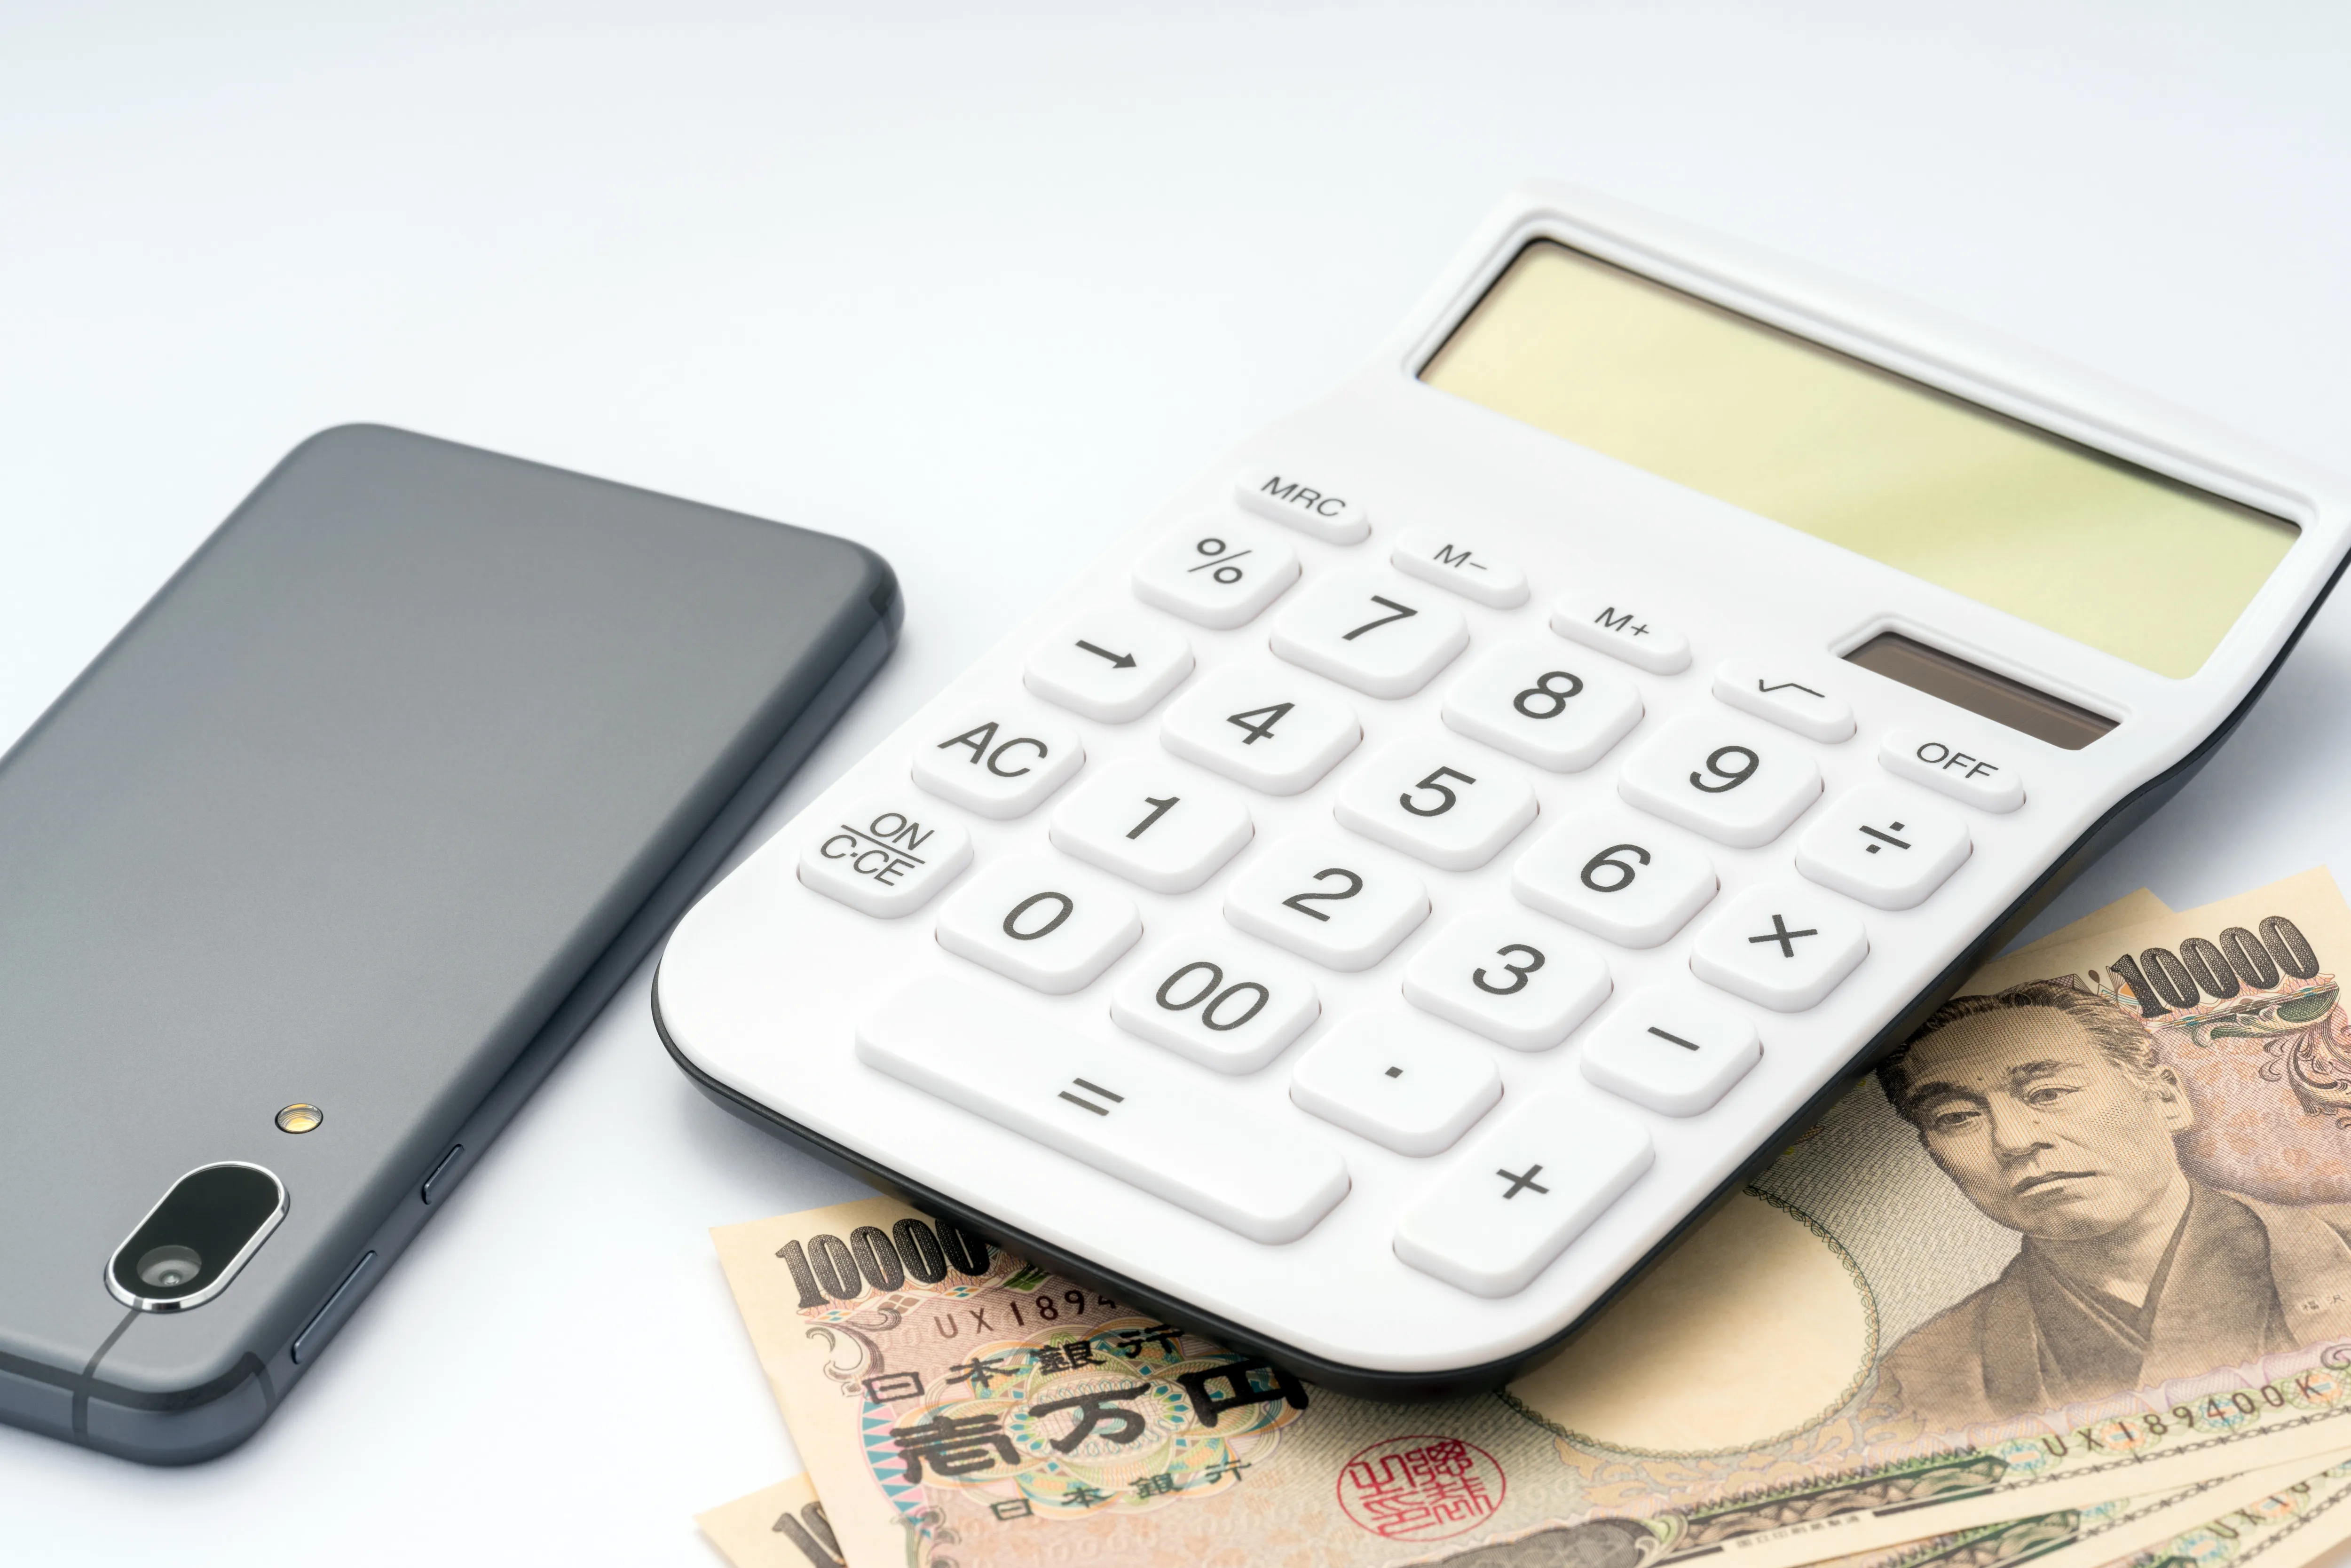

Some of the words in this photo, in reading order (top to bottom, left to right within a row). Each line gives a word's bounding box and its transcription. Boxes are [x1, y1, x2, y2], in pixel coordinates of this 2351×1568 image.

[1261, 476, 1346, 517] MRC
[1188, 537, 1252, 584] %
[1341, 595, 1419, 641] 7
[1594, 606, 1649, 636] M+
[1513, 670, 1584, 720] 8
[1226, 702, 1296, 746] 4
[936, 721, 1049, 778] AC
[1689, 745, 1760, 794] 9
[1916, 742, 1999, 779] OFF
[1399, 765, 1477, 818] 5
[869, 812, 935, 851] ON
[1125, 796, 1181, 840] 1
[1580, 843, 1651, 893] 6
[1002, 891, 1074, 941] 0
[1281, 867, 1364, 922] 2
[1472, 943, 1546, 996] 3
[2110, 915, 2320, 1018] 10000
[1155, 961, 1270, 1032] 00
[1057, 1077, 1125, 1117] =
[1496, 1164, 1550, 1200] +
[775, 1218, 990, 1309] 10000
[862, 1323, 1185, 1404] 日本銀行
[2042, 1375, 2323, 1458] UX189400K
[990, 1459, 1252, 1521] 日本銀行
